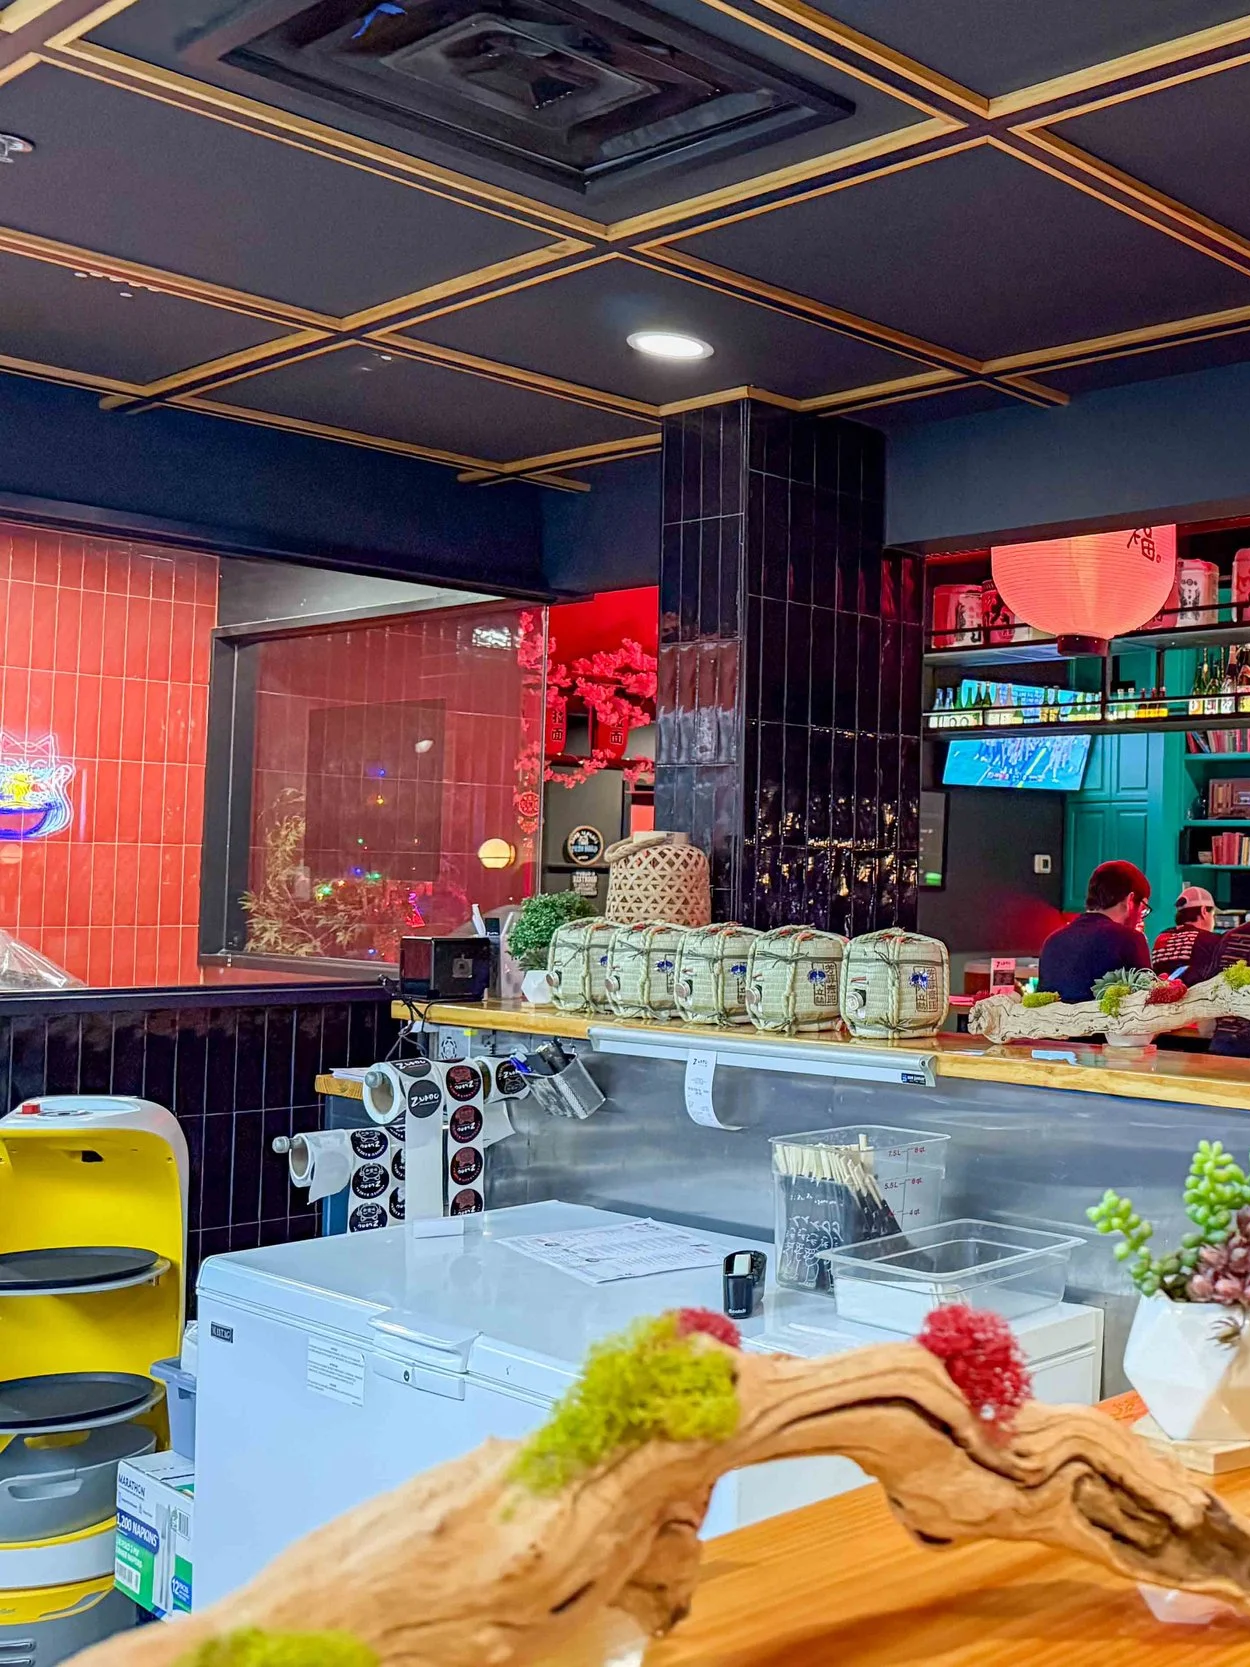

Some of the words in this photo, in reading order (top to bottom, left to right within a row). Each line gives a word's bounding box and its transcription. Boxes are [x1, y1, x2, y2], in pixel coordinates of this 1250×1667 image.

[118, 1474, 146, 1498] MARATHON
[117, 1512, 132, 1532] 1,200
[132, 1521, 158, 1547] NAPKINS
